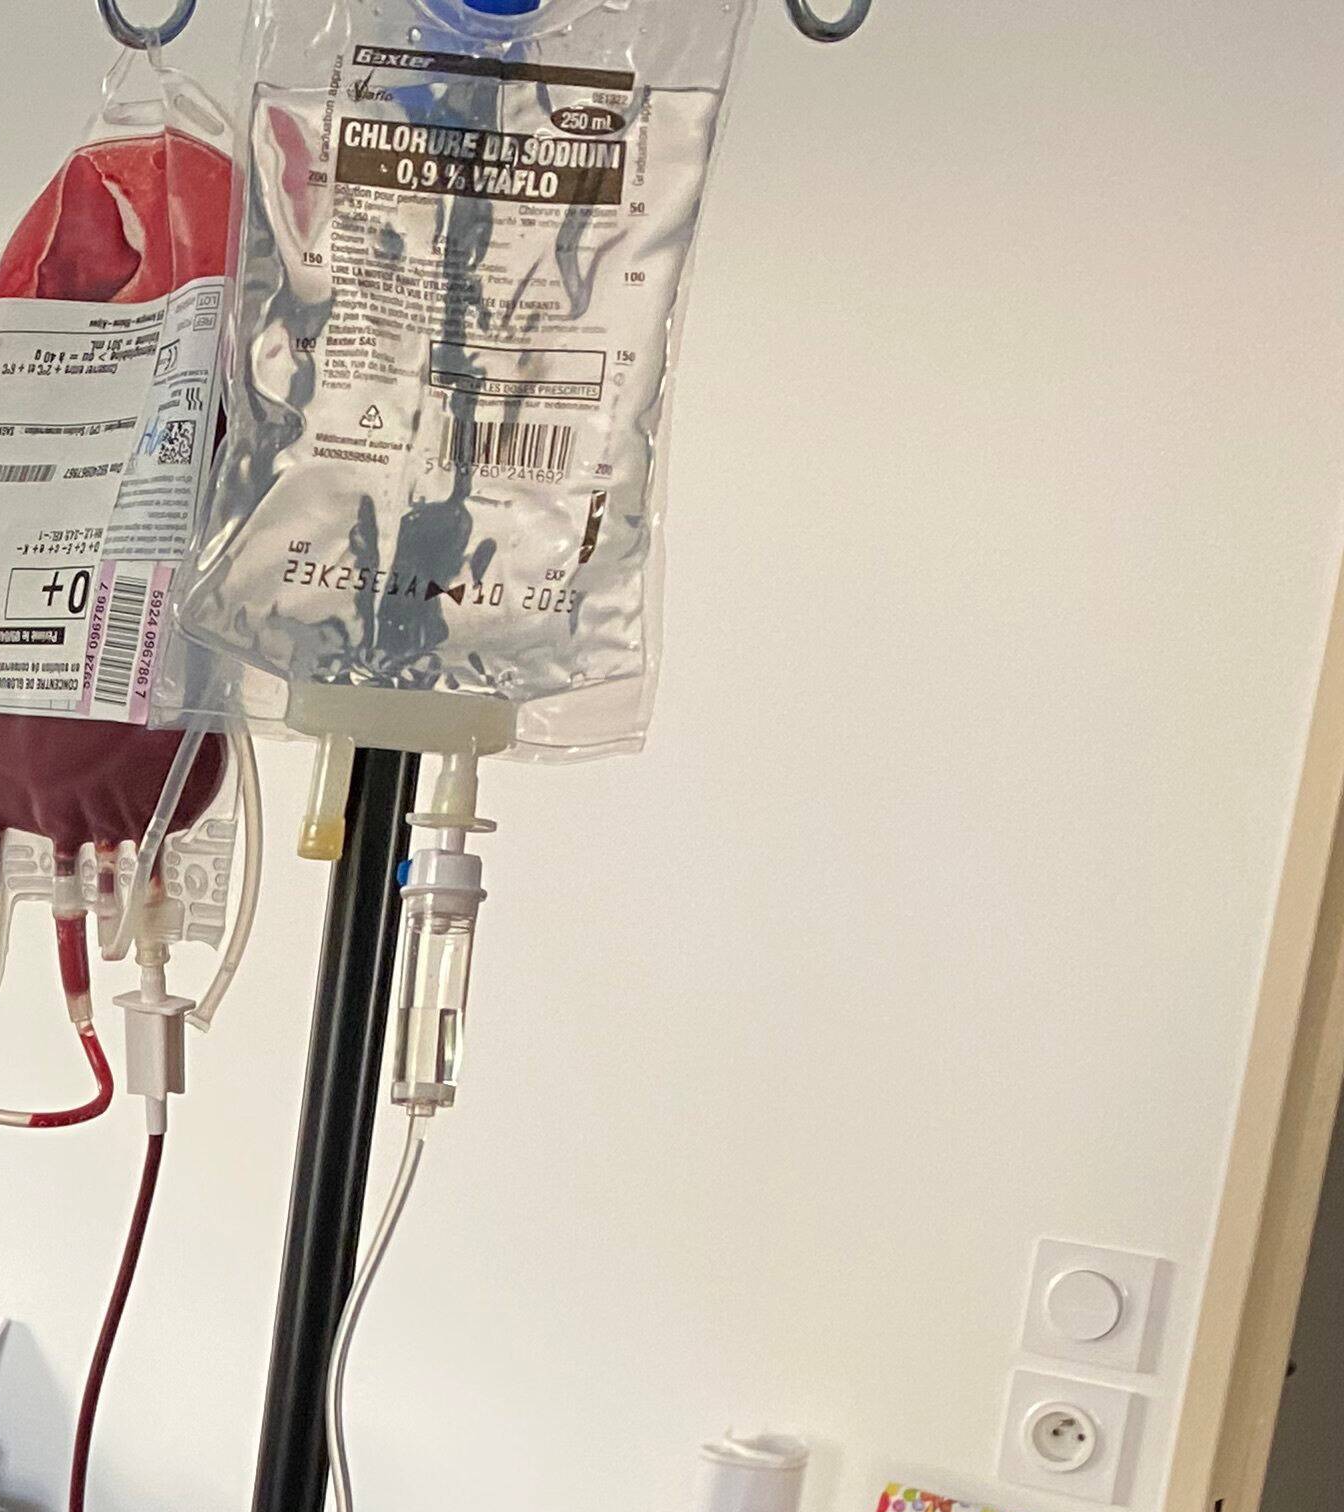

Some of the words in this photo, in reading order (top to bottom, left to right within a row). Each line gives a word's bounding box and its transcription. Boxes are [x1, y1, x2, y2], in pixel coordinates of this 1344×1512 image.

[356, 48, 435, 69] Baxter
[561, 112, 588, 130] 250
[319, 100, 335, 162] Graduation
[344, 121, 478, 161] CHLORURE
[482, 135, 518, 168] DE
[521, 137, 622, 170] SODIUM
[396, 158, 439, 191] 0,9
[444, 164, 465, 190] %
[473, 163, 560, 199] VIAFLO
[629, 202, 645, 214] 50
[303, 252, 323, 265] 150
[624, 271, 646, 283] 100
[294, 337, 317, 349] 100
[326, 336, 357, 347] Baxter
[483, 382, 502, 394] LES
[503, 383, 536, 396] DOSES
[538, 384, 599, 398] PRESCRITES
[507, 466, 564, 485] 241692
[288, 540, 312, 555] LOT
[544, 568, 566, 582] EXP
[472, 582, 505, 608] 10
[146, 590, 164, 627] 5924
[136, 631, 157, 686] 096786
